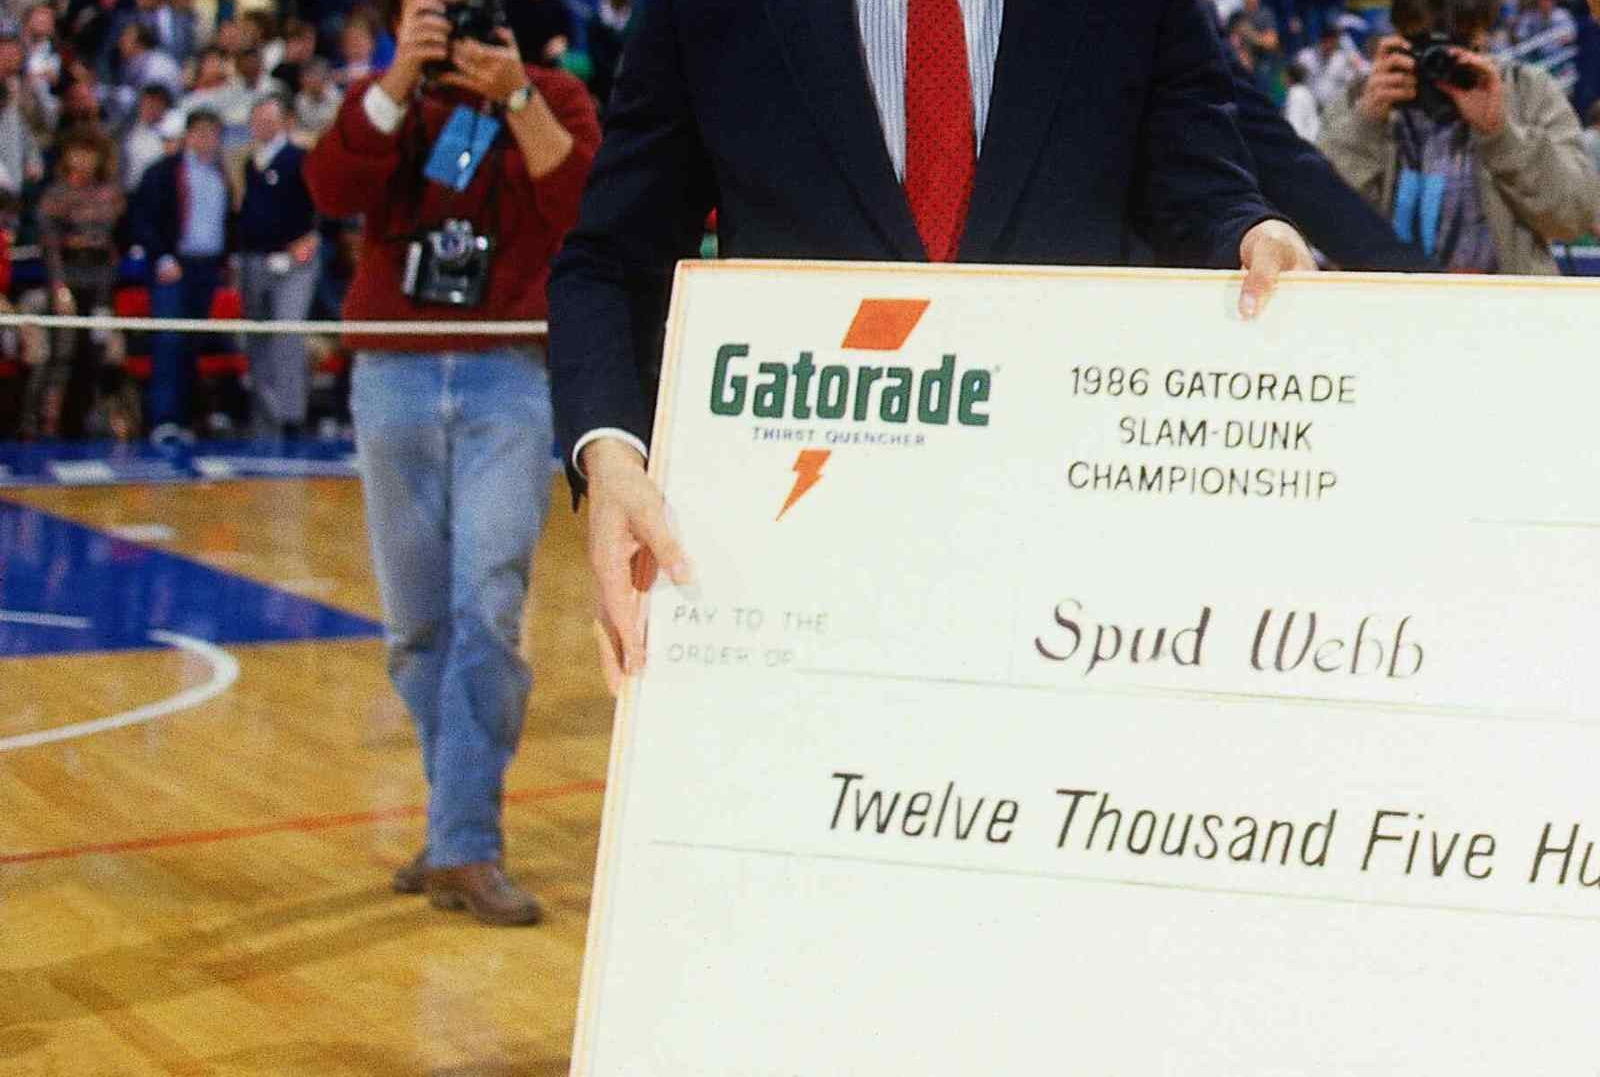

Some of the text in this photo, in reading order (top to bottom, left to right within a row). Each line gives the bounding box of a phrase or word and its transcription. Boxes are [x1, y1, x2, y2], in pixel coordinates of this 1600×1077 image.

[710, 343, 992, 427] Gatorade
[1072, 367, 1357, 404] 1986 GATORADE
[753, 426, 926, 446] THIRST QUENCHER
[1120, 417, 1312, 449] SLAM-DUNK
[1068, 461, 1336, 497] CHAMPIONSHIP
[672, 605, 829, 632] PAY TO THE
[1034, 598, 1423, 677] Spud Webb
[830, 773, 1018, 843] Twelve
[1056, 789, 1337, 867] Thousand
[1361, 810, 1496, 879] Five
